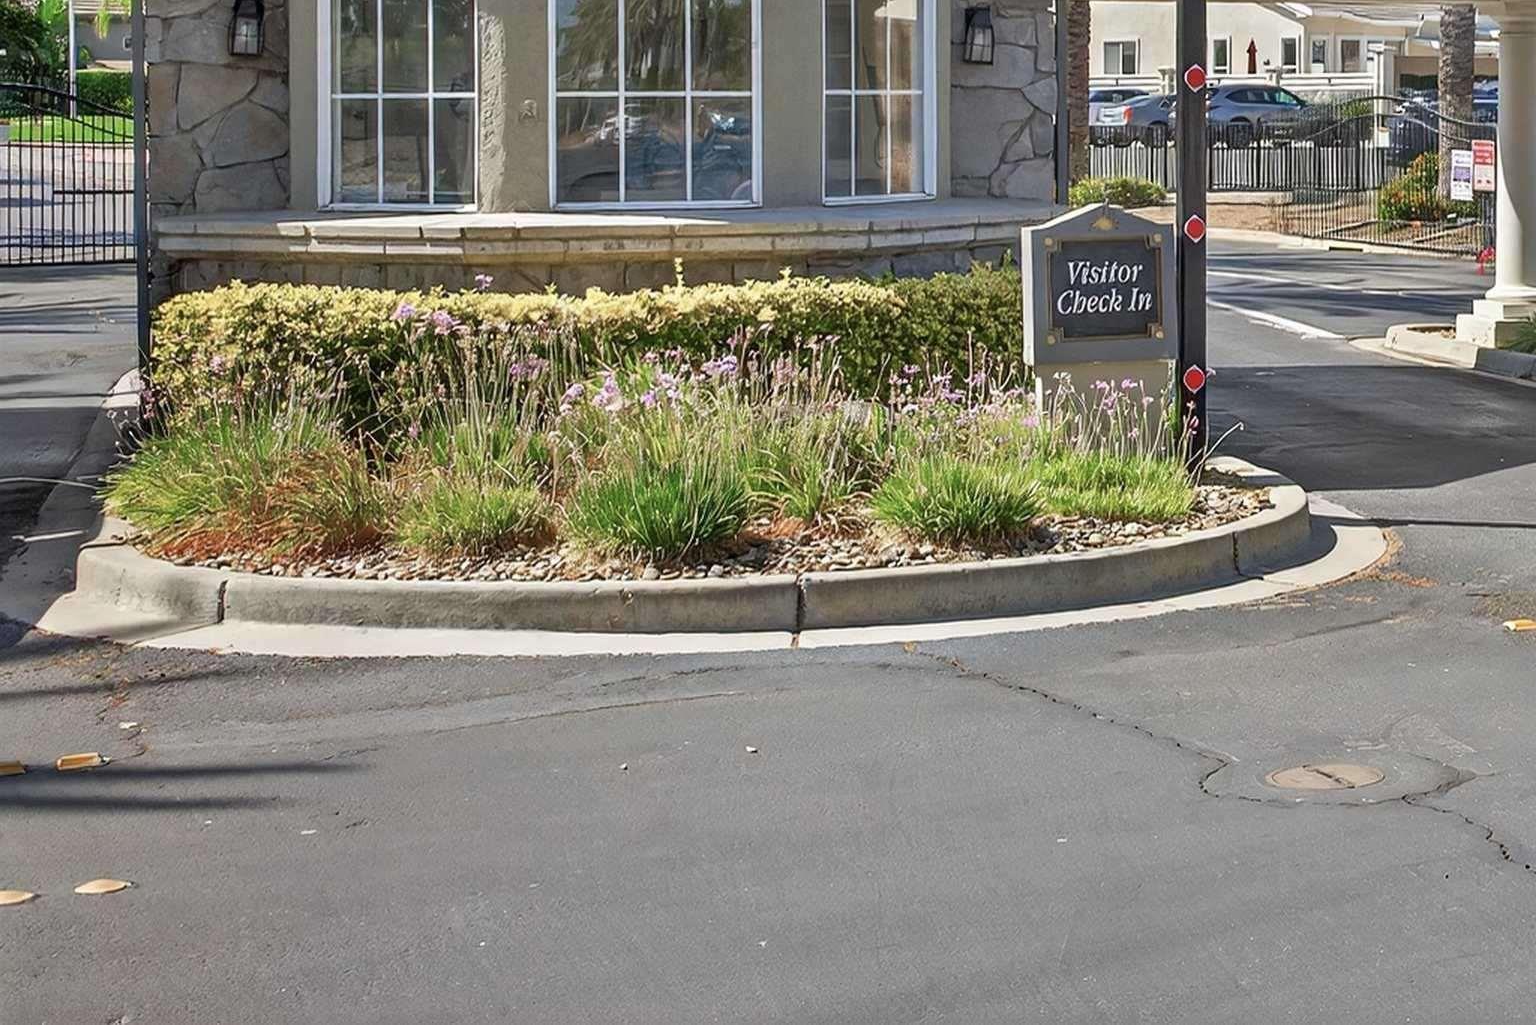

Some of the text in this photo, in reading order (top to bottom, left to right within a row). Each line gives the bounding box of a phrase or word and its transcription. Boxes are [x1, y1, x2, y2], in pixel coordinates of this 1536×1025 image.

[1067, 260, 1144, 286] Visitor
[1057, 286, 1153, 315] Check In
